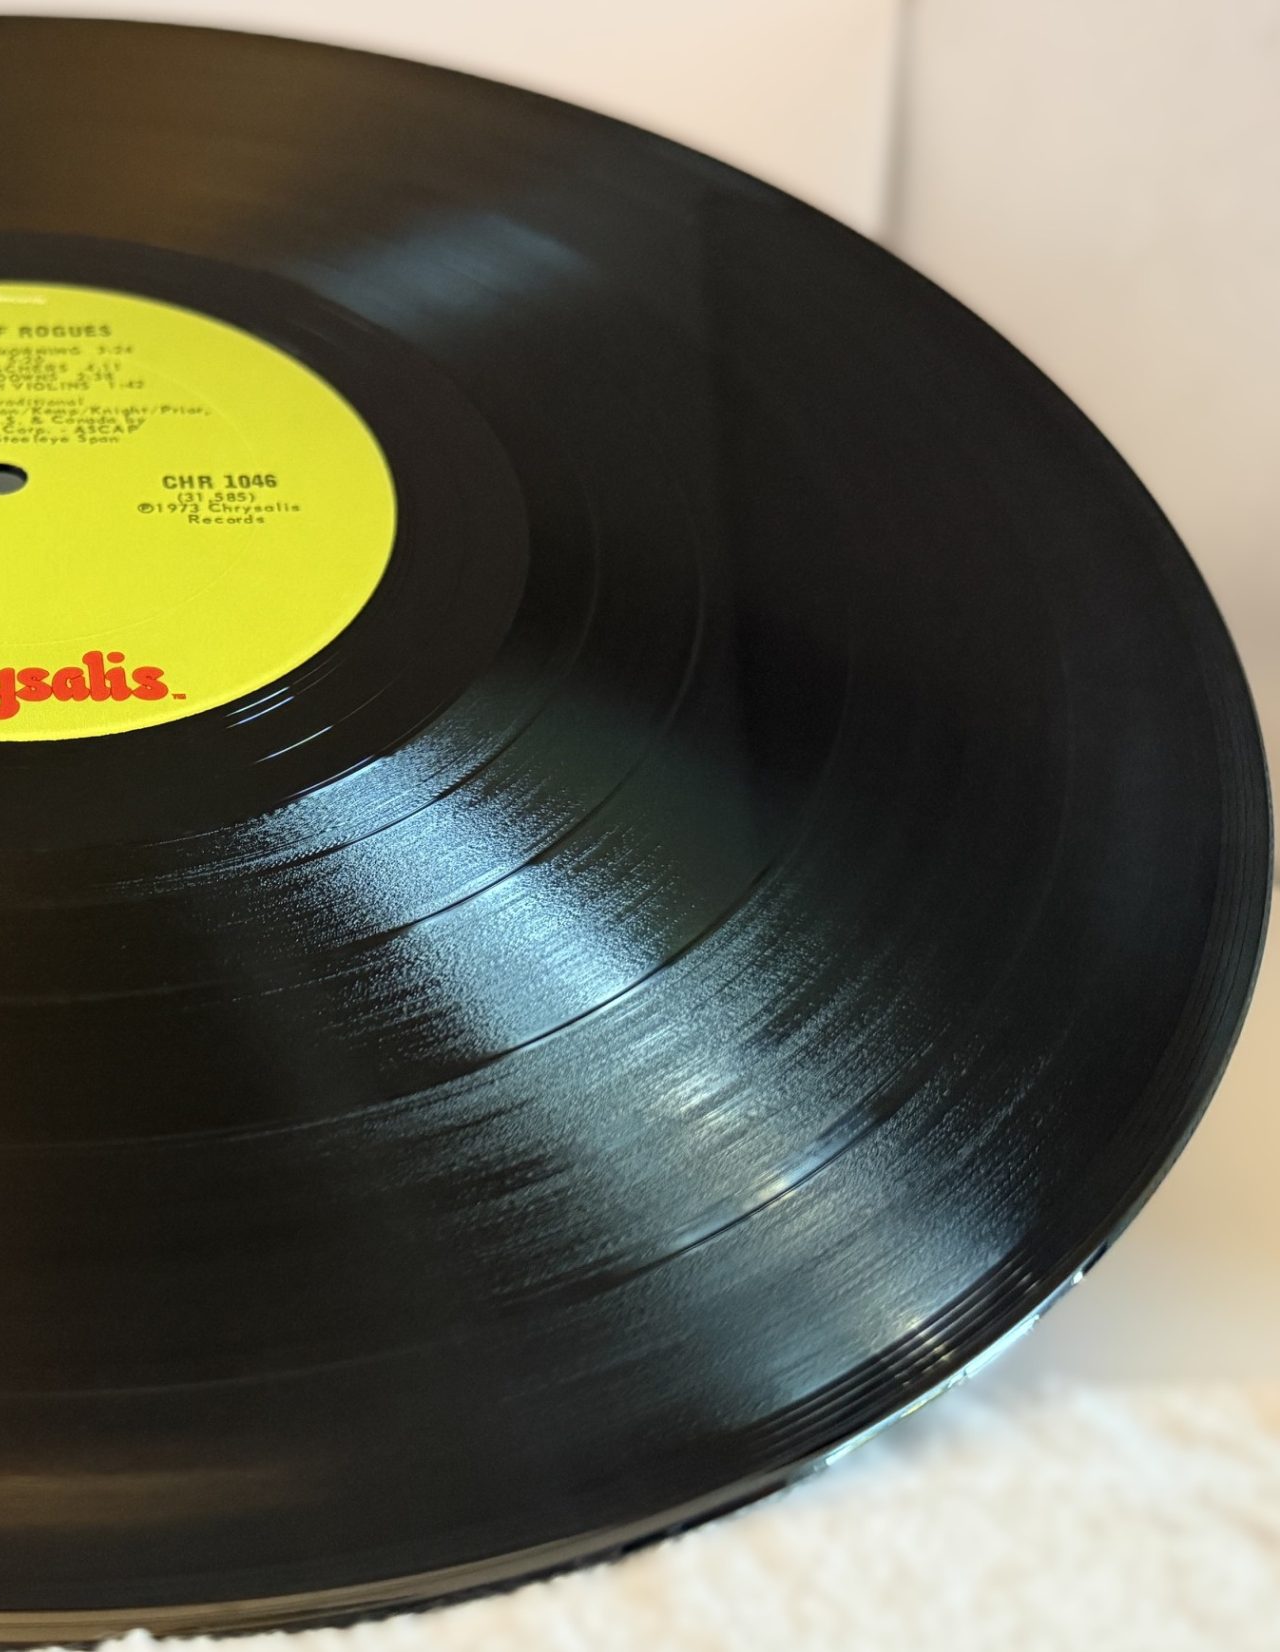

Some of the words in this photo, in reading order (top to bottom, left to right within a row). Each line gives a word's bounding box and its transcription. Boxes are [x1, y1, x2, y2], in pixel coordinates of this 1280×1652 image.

[18, 325, 112, 338] ROGUES
[13, 382, 90, 391] VIOLINS
[31, 416, 43, 425] &
[51, 415, 117, 425] Canada
[124, 416, 146, 426] by
[3, 425, 52, 436] Corp.
[74, 425, 140, 434] ASCAP
[78, 434, 120, 445] Span
[162, 475, 214, 490] CHR
[224, 474, 278, 489] 1046
[208, 503, 302, 515] Chrysalis
[188, 514, 265, 525] Records
